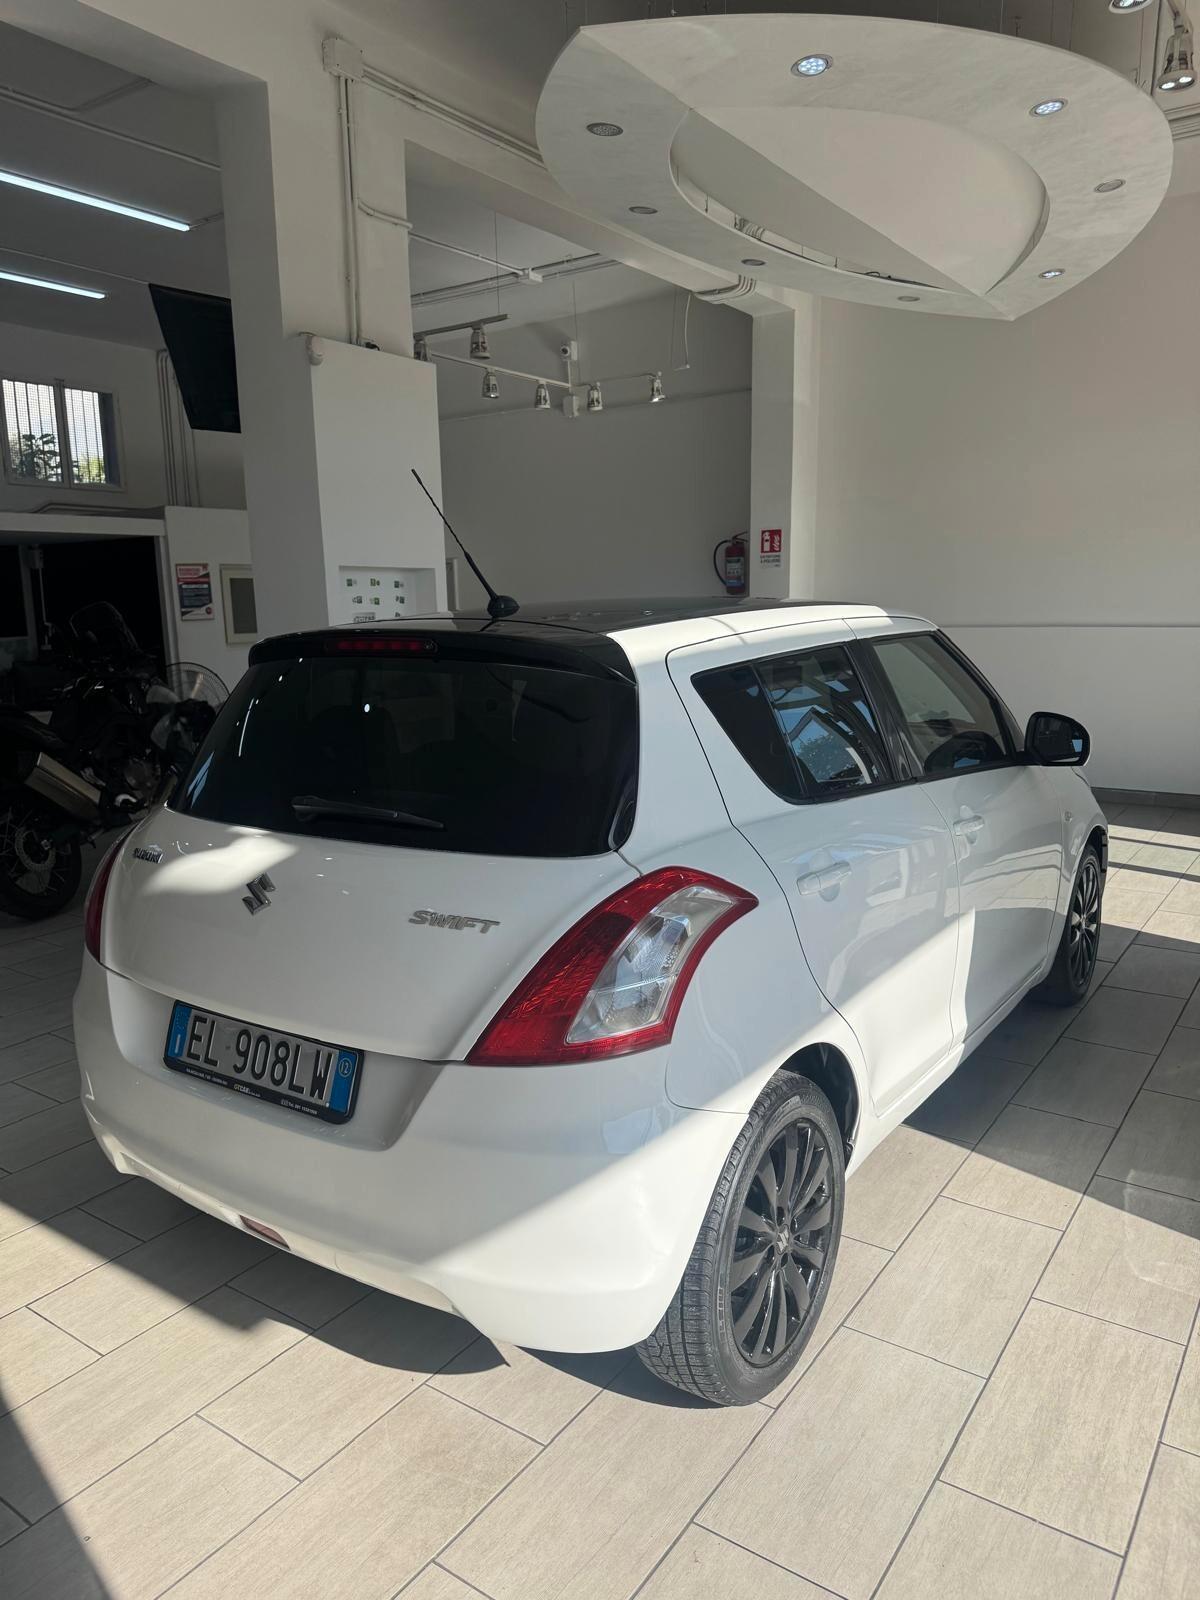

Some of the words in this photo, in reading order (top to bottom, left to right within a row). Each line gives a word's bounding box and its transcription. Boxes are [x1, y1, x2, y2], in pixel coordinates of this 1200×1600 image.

[407, 909, 501, 934] SWIFT
[186, 1014, 220, 1068] EL
[232, 1028, 333, 1101] 908LW
